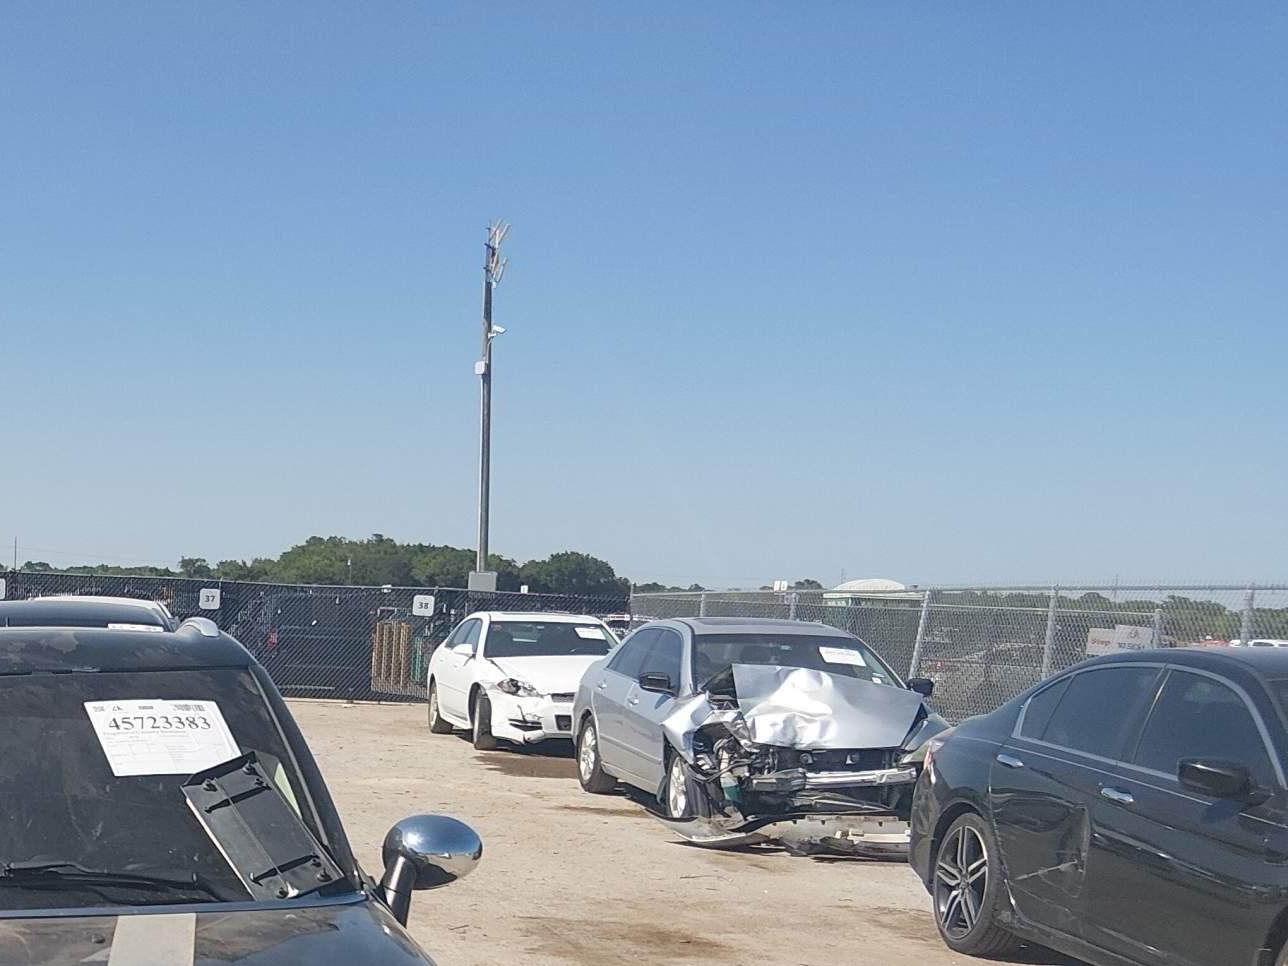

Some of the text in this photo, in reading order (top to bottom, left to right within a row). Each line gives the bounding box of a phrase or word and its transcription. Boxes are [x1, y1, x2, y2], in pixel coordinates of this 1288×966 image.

[205, 595, 216, 603] 37
[417, 601, 429, 610] 38
[108, 716, 211, 731] 45723383
